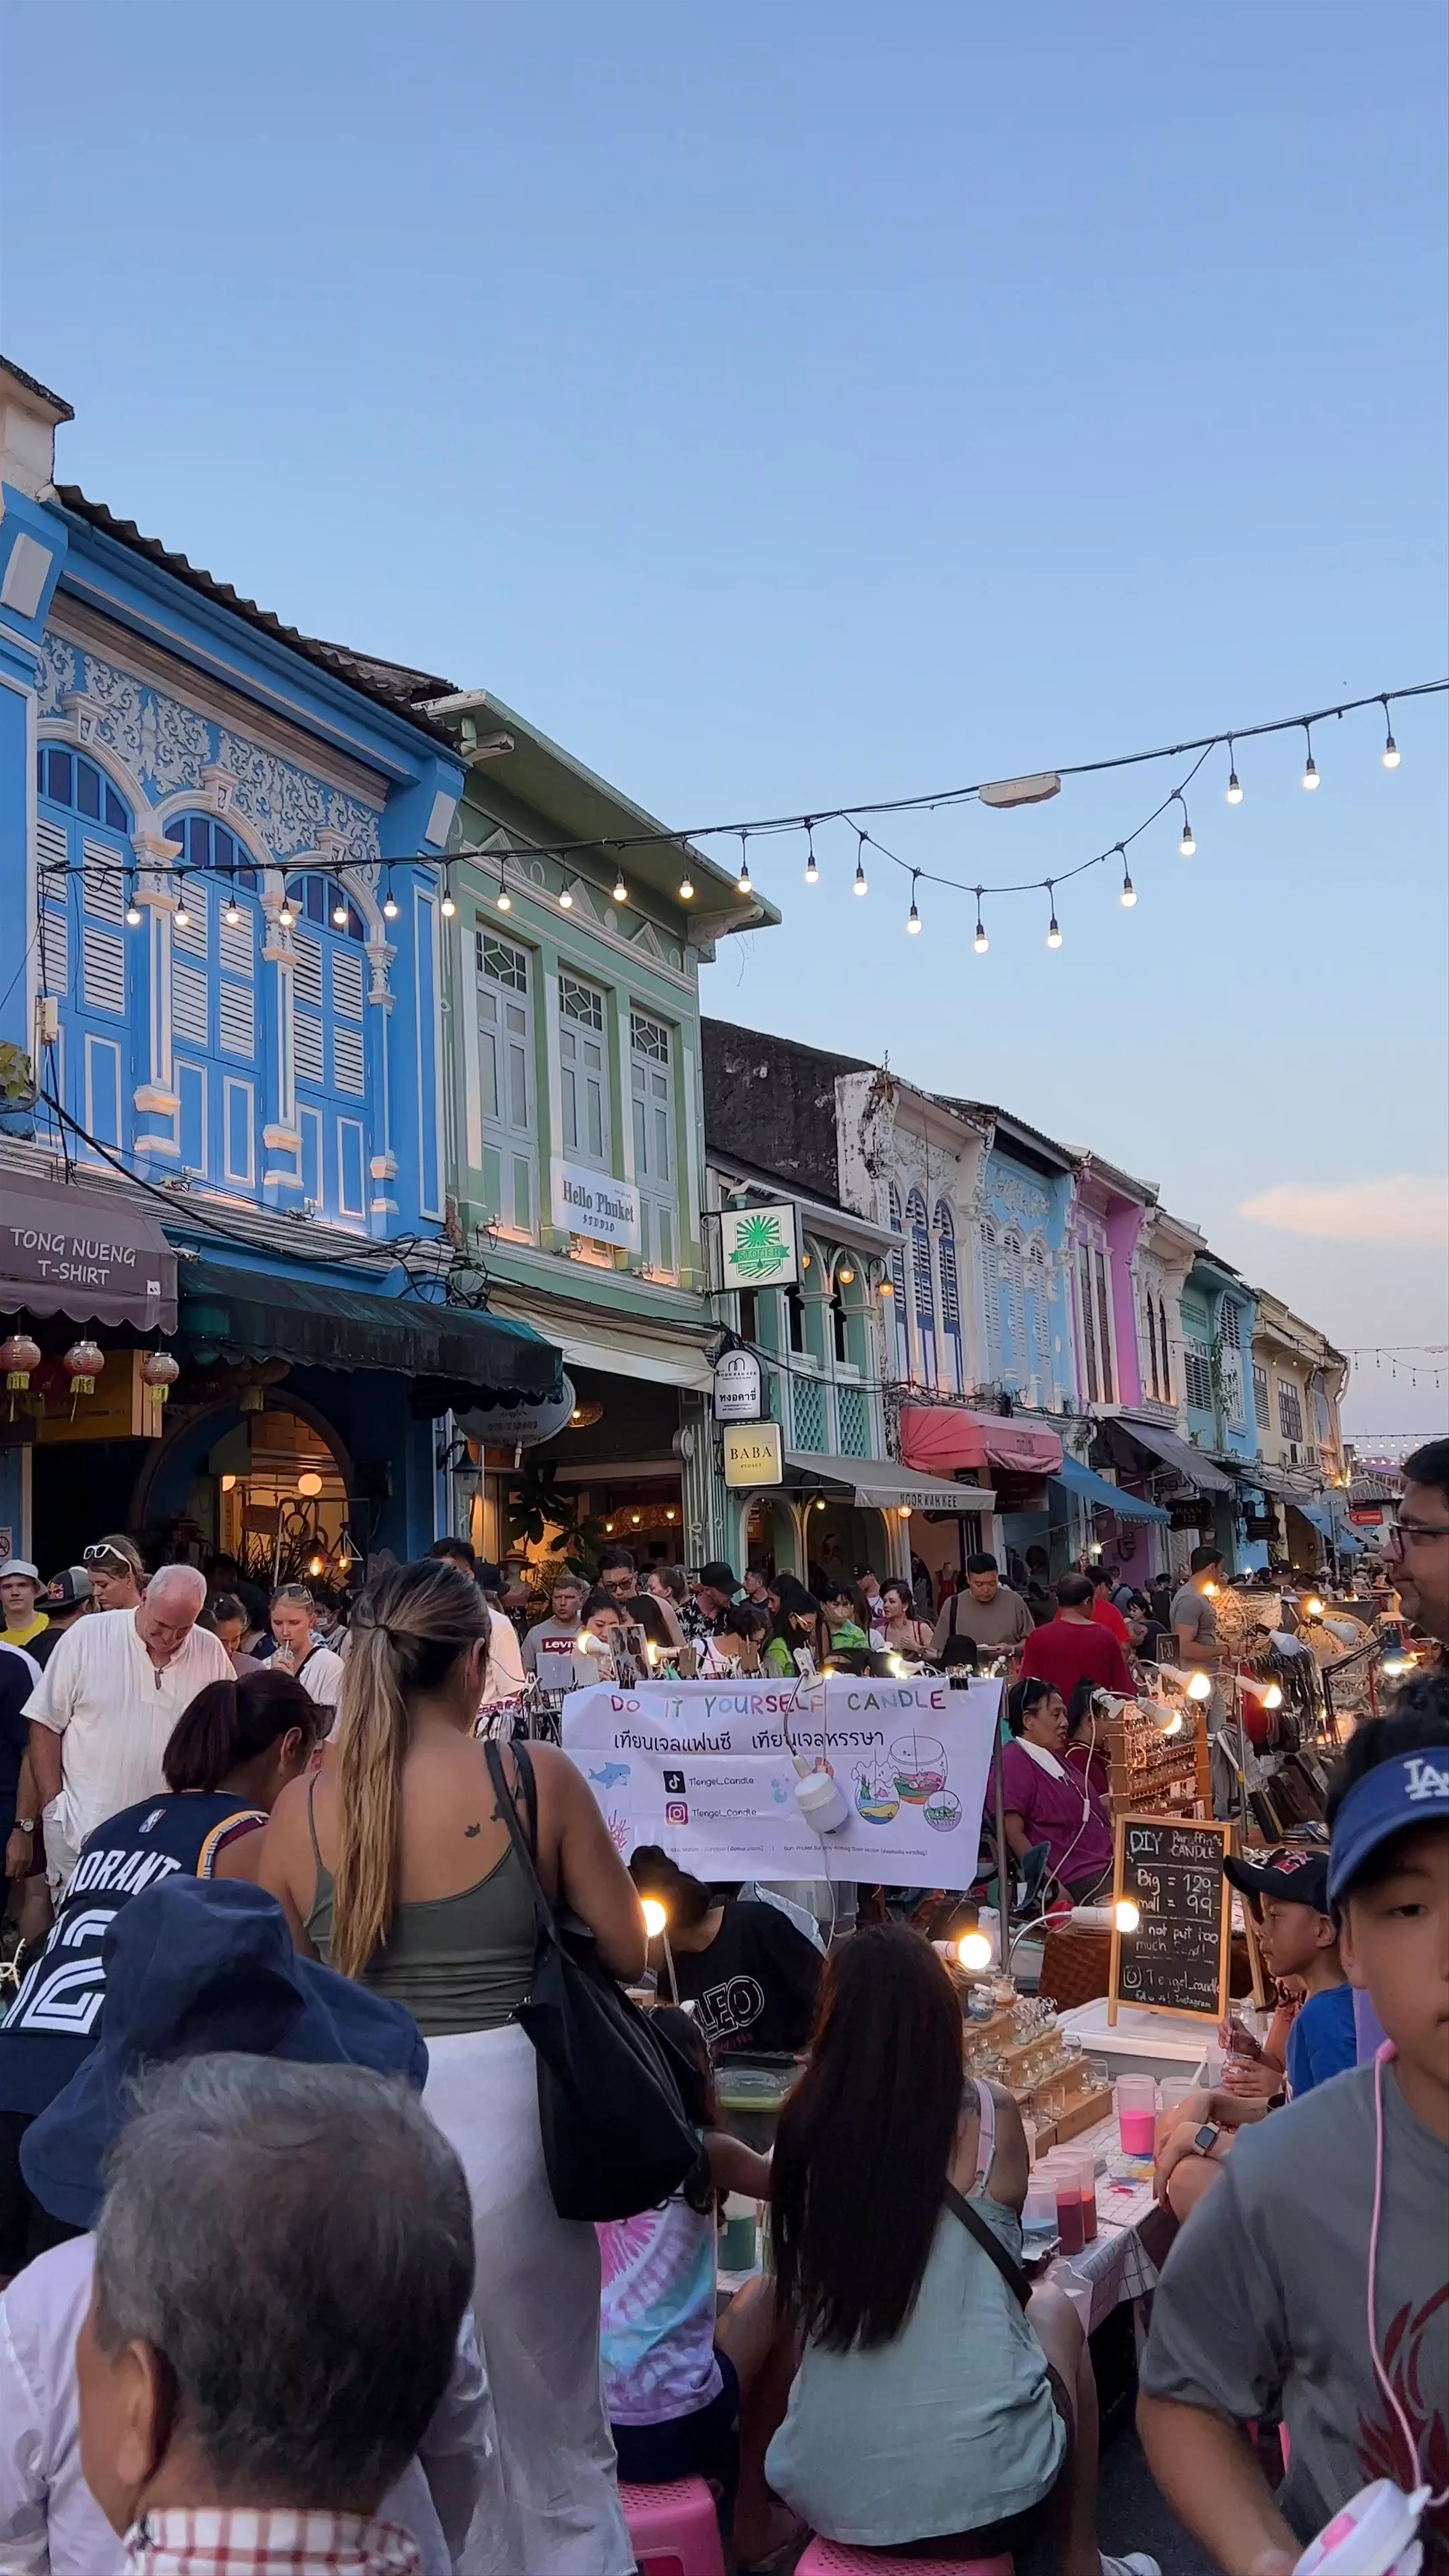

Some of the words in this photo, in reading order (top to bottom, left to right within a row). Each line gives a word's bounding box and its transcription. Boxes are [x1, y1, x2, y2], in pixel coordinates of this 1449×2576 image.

[563, 1180, 592, 1209] Hello
[595, 1192, 634, 1223] Phuket
[583, 1214, 615, 1232] STUDIO
[10, 1228, 65, 1255] TONG
[72, 1238, 135, 1267] NUENG
[38, 1260, 110, 1285] T-SHIRT
[731, 1446, 772, 1459] BABA
[924, 1495, 940, 1507] KAH
[942, 1495, 957, 1508] KEE
[610, 1694, 641, 1712] DO
[665, 1696, 683, 1718] IT
[705, 1693, 825, 1717] YOURSELF
[848, 1689, 947, 1711] CANDLE
[615, 1730, 732, 1752] เทียนเจลแฟนซี
[1403, 1758, 1449, 1801] LA
[1130, 1830, 1163, 1855] DIY
[1171, 1845, 1218, 1862] CANDLE
[60, 1850, 182, 1905] MORANT
[1137, 1869, 1160, 1896] Big
[1136, 1938, 1167, 1952] much
[1148, 1922, 1168, 1936] not
[1173, 1925, 1193, 1940] put
[1198, 1927, 1219, 1945] too
